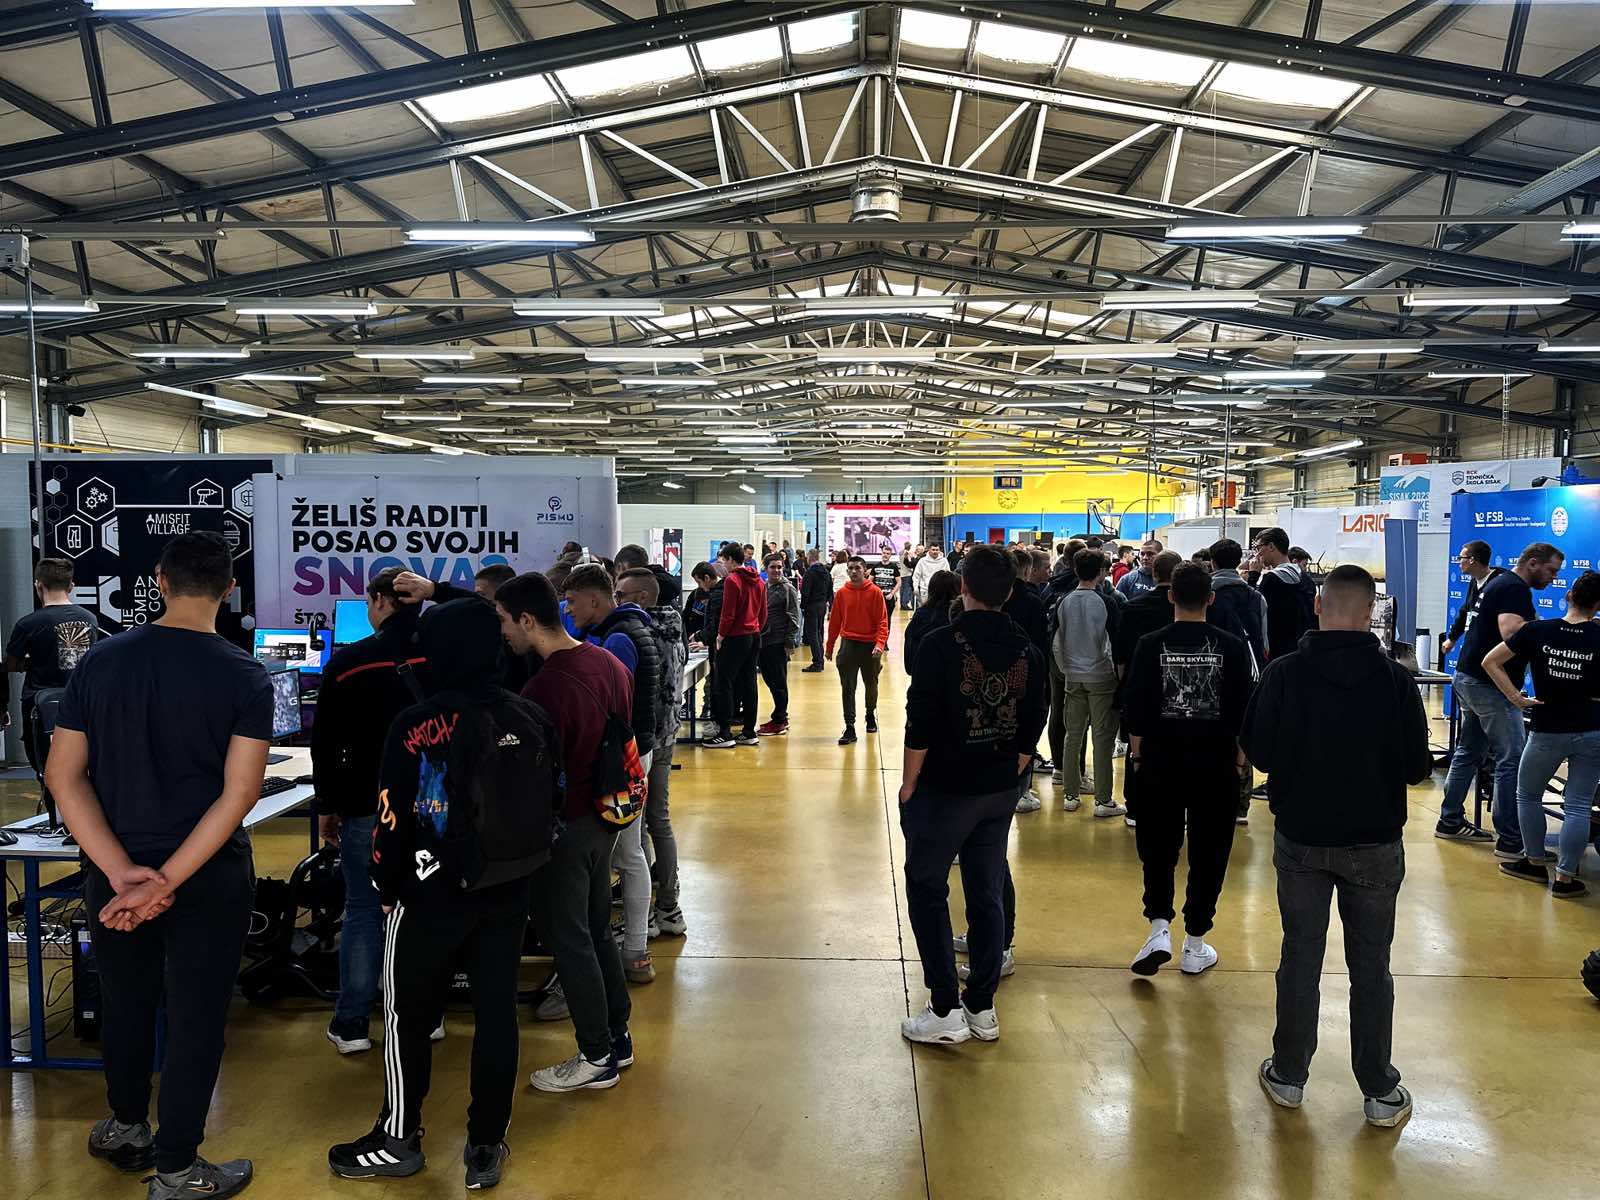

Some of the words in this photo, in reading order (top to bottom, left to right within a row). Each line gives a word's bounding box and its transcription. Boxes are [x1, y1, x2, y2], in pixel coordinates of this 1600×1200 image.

[291, 497, 377, 527] ŽELIŠ
[386, 504, 488, 528] RADITI
[536, 513, 574, 521] PISMO
[1486, 511, 1504, 522] FSB
[146, 523, 191, 534] VILLAGE
[1343, 513, 1389, 532] LARIC
[292, 530, 398, 553] POSAO
[405, 530, 519, 553] SVOJIH
[1542, 644, 1594, 661] Certified
[1548, 657, 1582, 671] Robot
